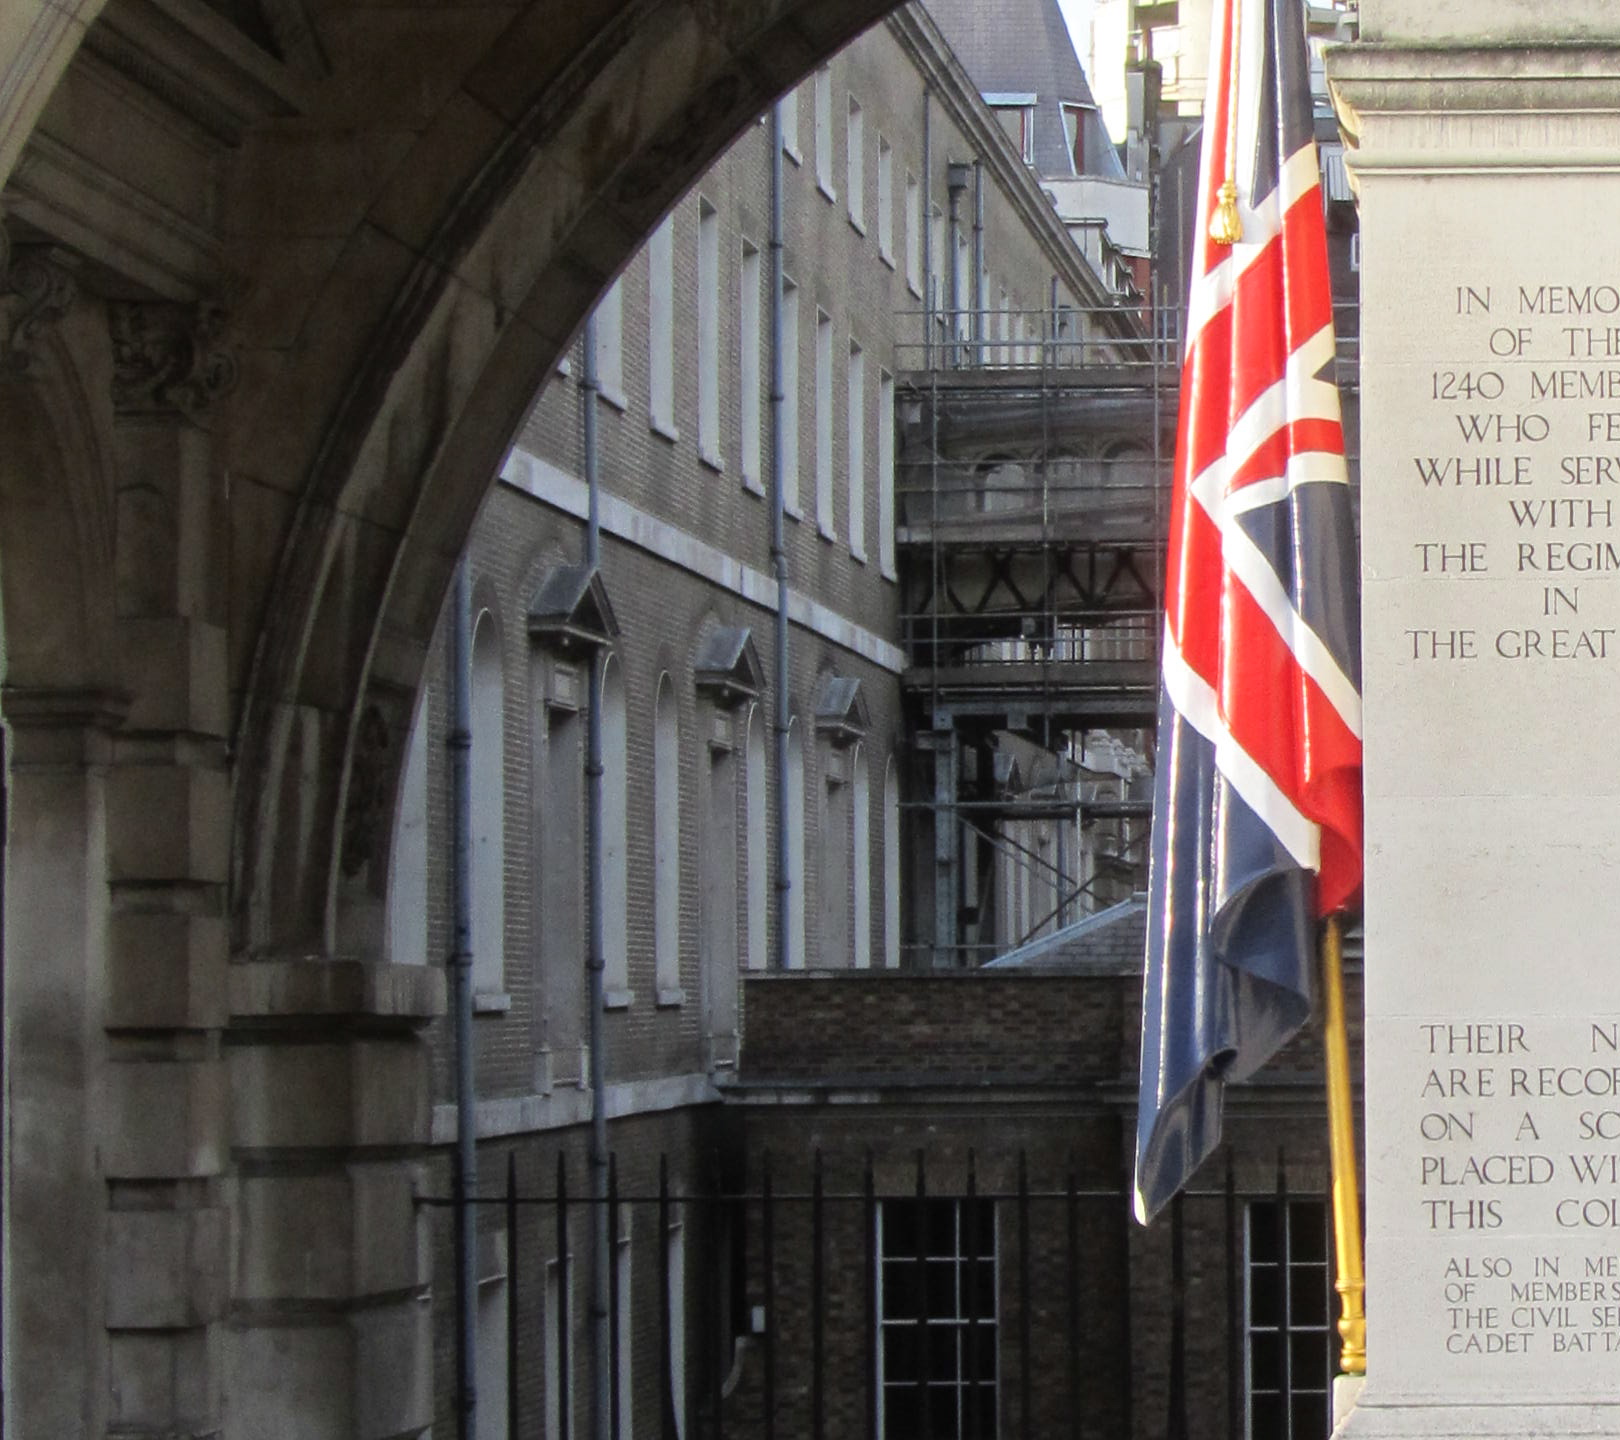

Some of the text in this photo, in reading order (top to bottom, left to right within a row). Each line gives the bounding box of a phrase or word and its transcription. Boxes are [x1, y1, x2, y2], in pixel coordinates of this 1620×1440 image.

[1456, 286, 1491, 314] IN
[1489, 328, 1533, 356] OF
[1432, 372, 1505, 400] 1240
[1455, 414, 1550, 442] WHO
[1413, 457, 1533, 486] WHILE
[1509, 499, 1612, 528] WITH
[1415, 543, 1488, 572] THE
[1543, 586, 1579, 615] IN
[1405, 630, 1478, 659] THE
[1495, 629, 1616, 659] GREAT
[1419, 1024, 1530, 1054] THEIR
[1421, 1068, 1495, 1098] ARE
[1420, 1112, 1474, 1141] ON
[1515, 1112, 1540, 1140] A
[1421, 1155, 1554, 1186] PLACED
[1422, 1200, 1503, 1229] THIS
[1444, 1257, 1512, 1279] ALSO
[1534, 1257, 1560, 1278] IN
[1445, 1282, 1476, 1303] OF
[1447, 1307, 1498, 1329] THE
[1511, 1306, 1578, 1328] CIVIL
[1446, 1333, 1534, 1354] CADET
